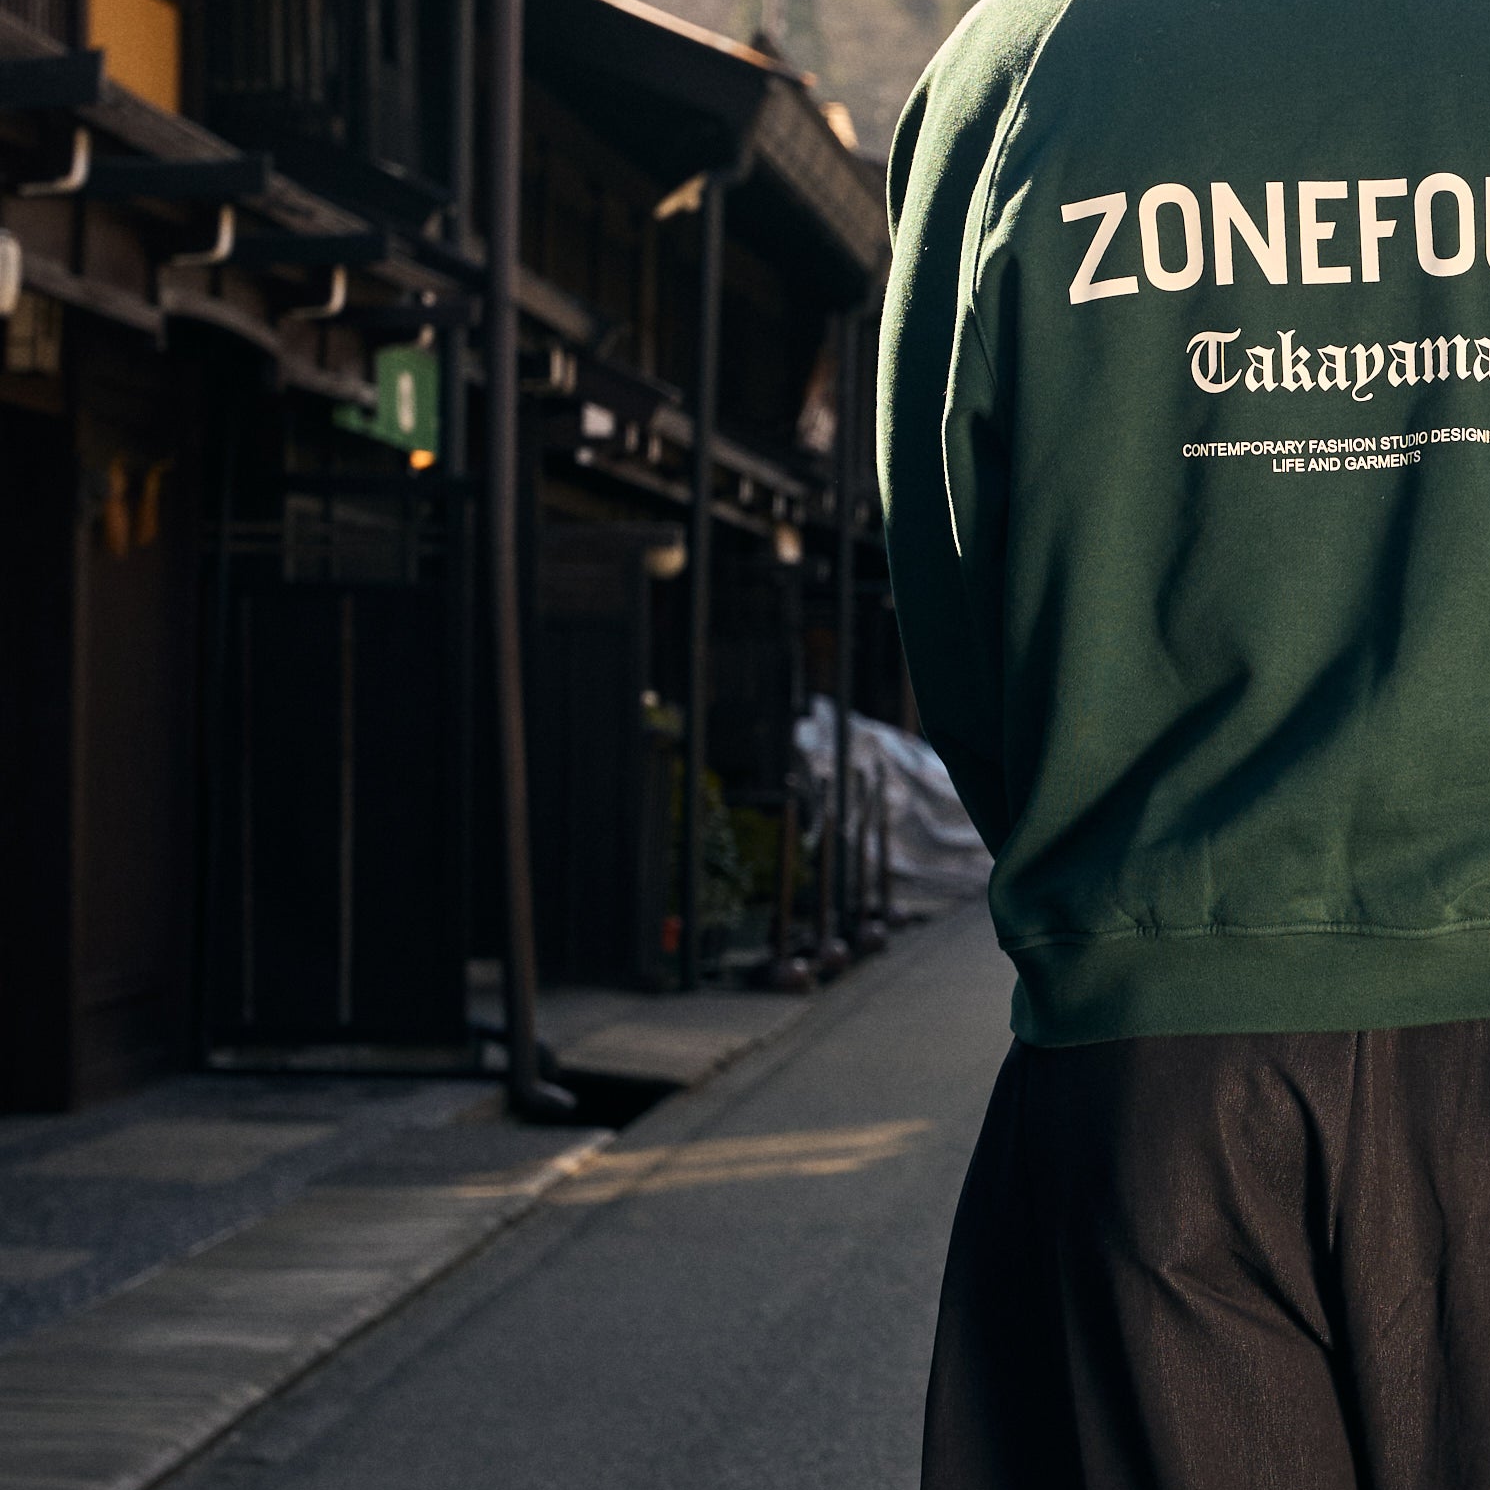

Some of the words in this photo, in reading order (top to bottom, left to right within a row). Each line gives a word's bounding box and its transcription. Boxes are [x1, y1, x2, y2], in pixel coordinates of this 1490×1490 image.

[1182, 440, 1306, 458] CONTEMPORARY
[1308, 436, 1377, 454] FASHION
[1379, 431, 1428, 451] STUDIO
[1272, 458, 1306, 473] LIFE
[1307, 457, 1342, 472] AND
[1344, 449, 1421, 471] GARMENTS
